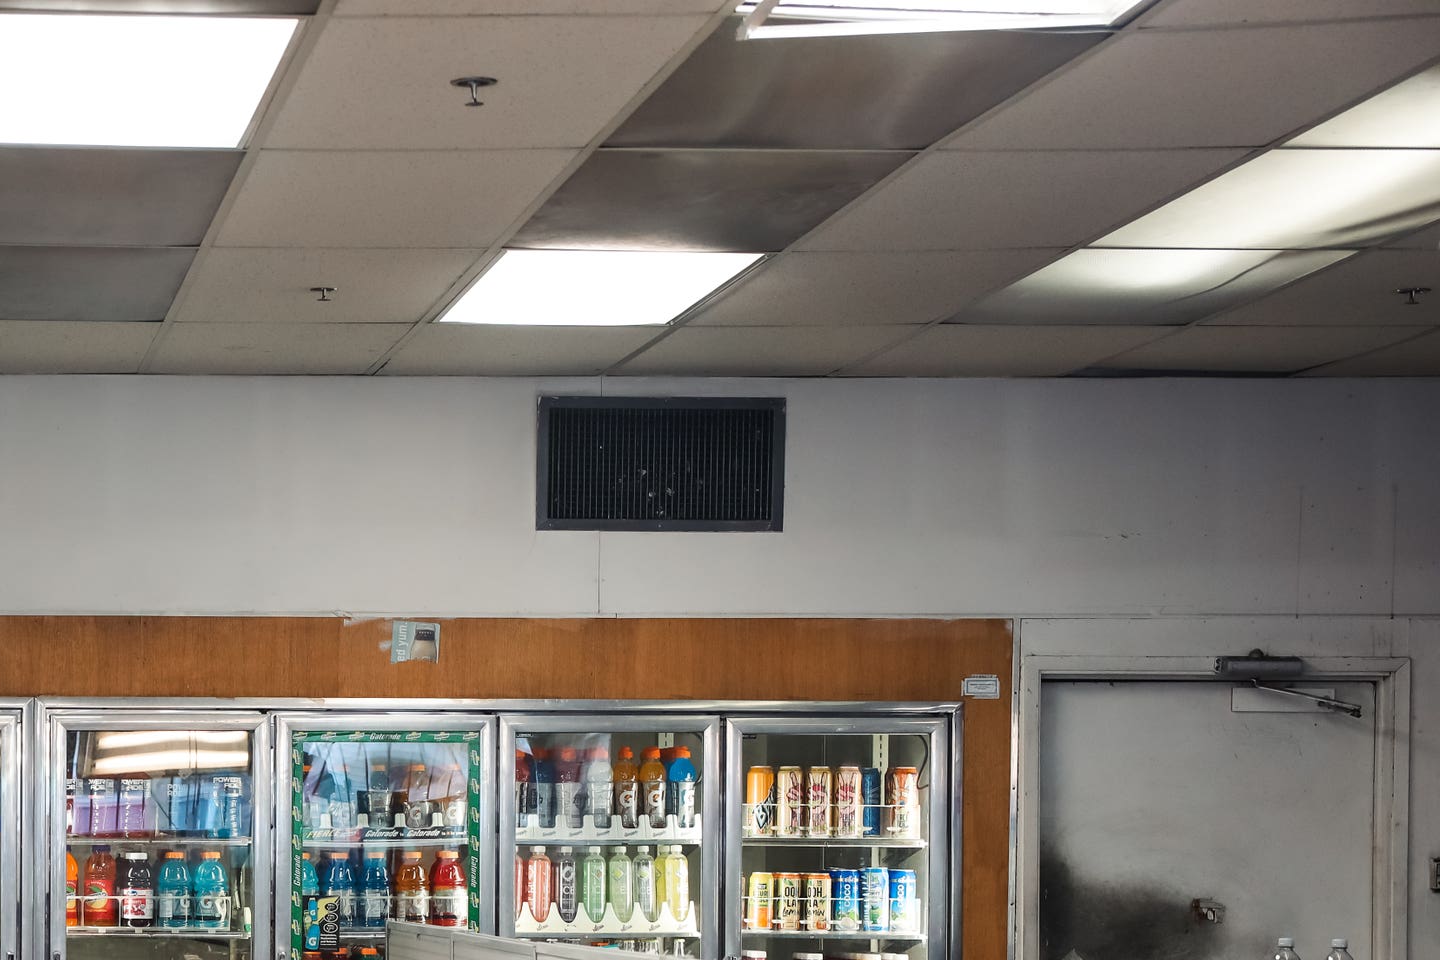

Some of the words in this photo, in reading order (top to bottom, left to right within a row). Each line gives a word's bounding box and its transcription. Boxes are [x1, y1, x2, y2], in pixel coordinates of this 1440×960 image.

[365, 829, 398, 838] Gatorade
[407, 829, 440, 837] Gatorade
[293, 854, 302, 887] Gatorade
[470, 855, 478, 888] Gatorade
[843, 883, 852, 907] COCO
[308, 935, 318, 947] G
